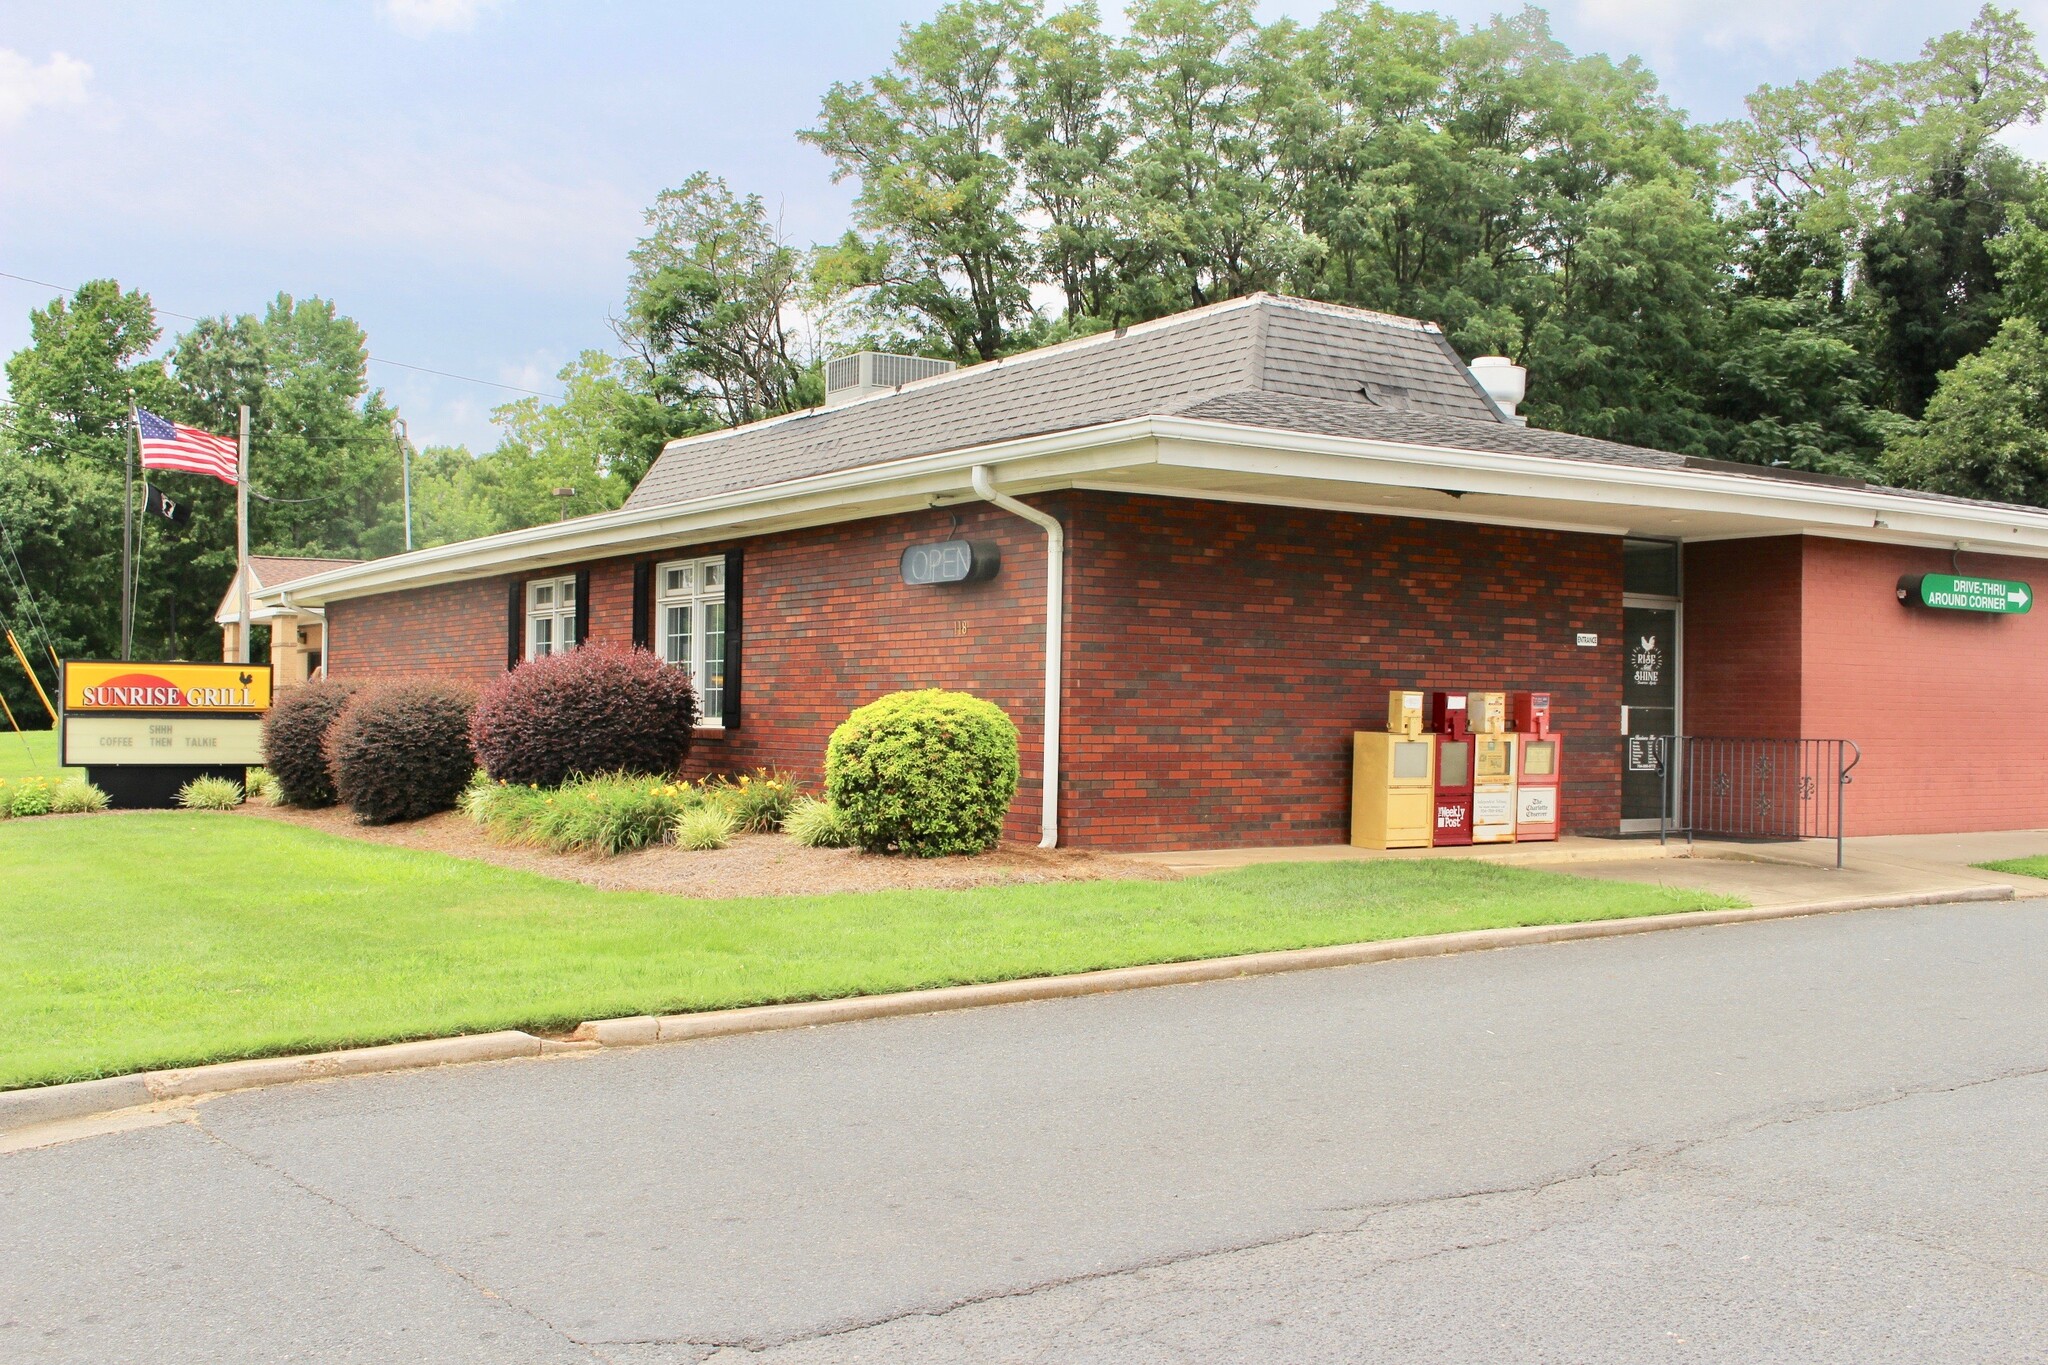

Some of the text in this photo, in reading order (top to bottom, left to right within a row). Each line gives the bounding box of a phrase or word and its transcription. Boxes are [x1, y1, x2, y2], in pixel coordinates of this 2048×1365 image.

[912, 547, 971, 580] OPEN
[1953, 579, 2006, 597] DRIVE-THRU
[1928, 592, 2006, 610] AROUND CORNER
[954, 620, 968, 636] 118
[1637, 654, 1656, 664] RISE
[1634, 671, 1658, 681] SHINE
[82, 686, 256, 707] SUNRISE GRILL
[149, 724, 173, 735] SHHH
[99, 736, 217, 748] COFFEE THEN TALKIE
[1441, 805, 1466, 820] Weekly
[1444, 817, 1461, 828] Post
